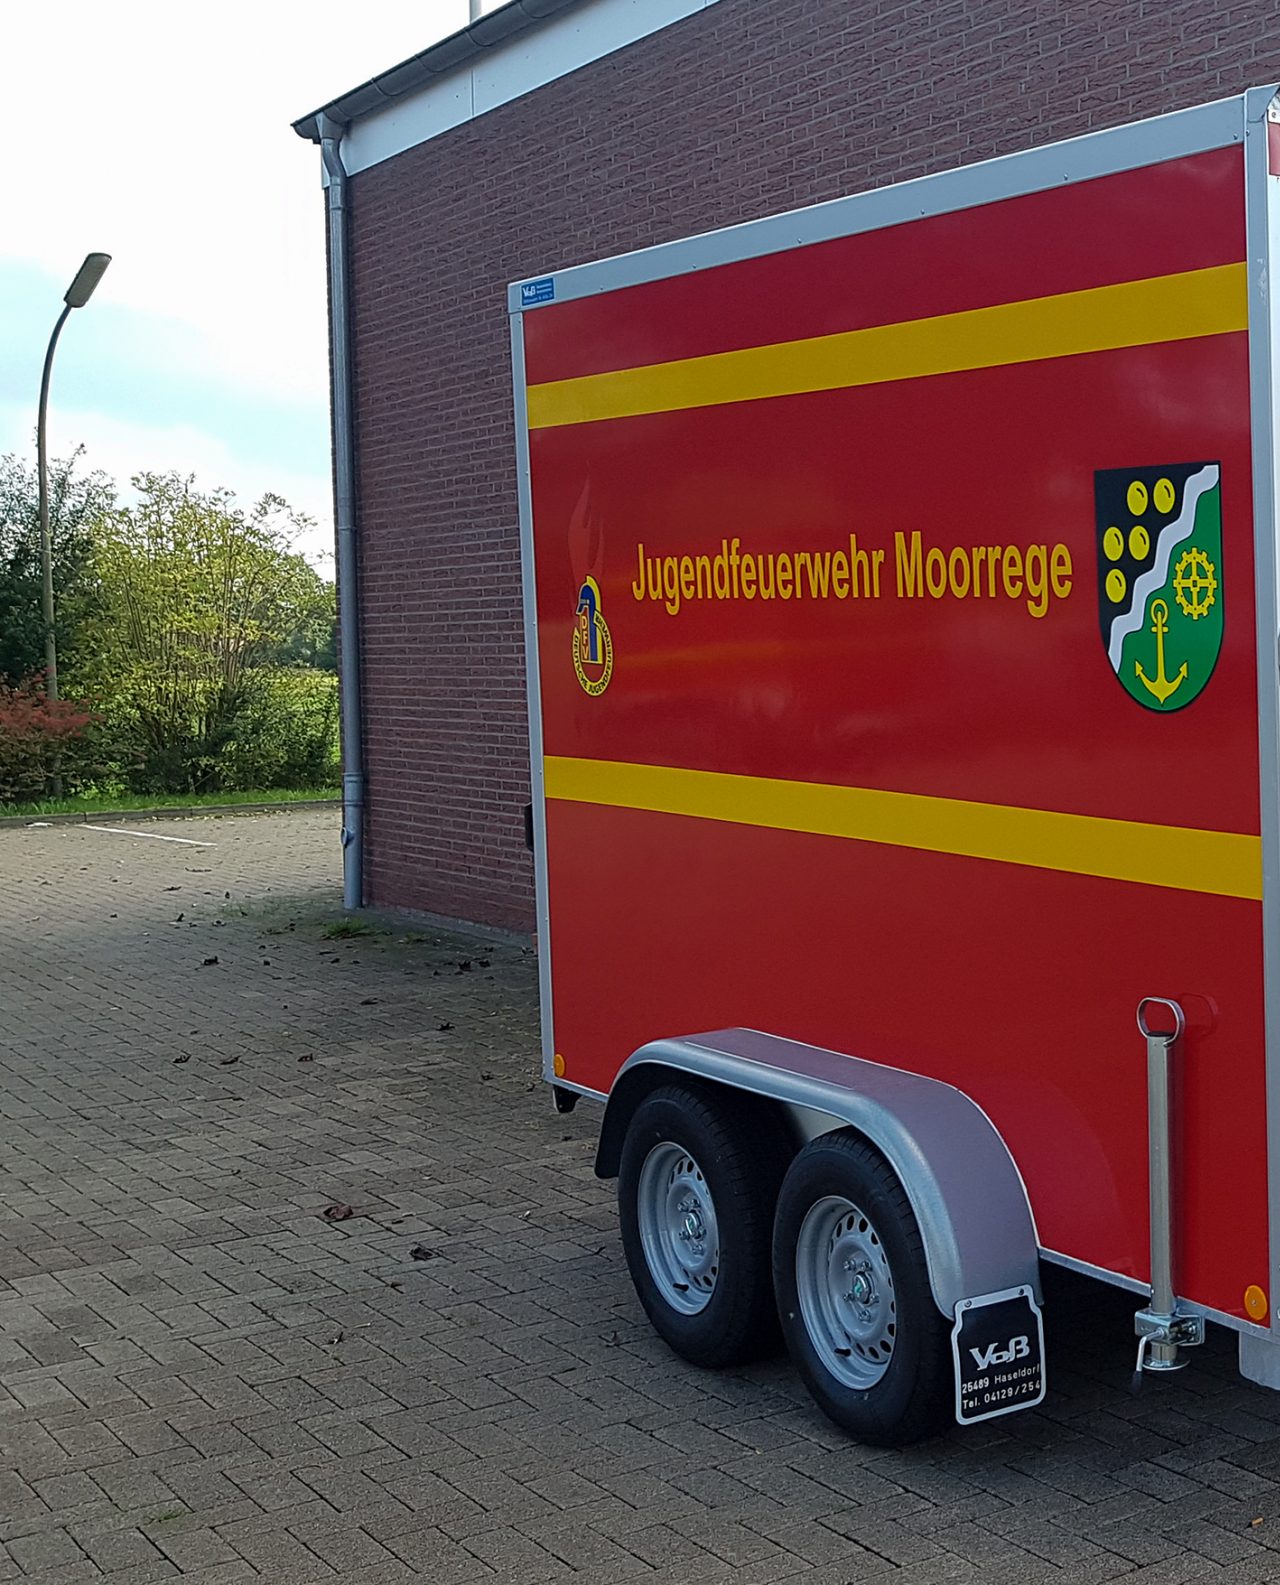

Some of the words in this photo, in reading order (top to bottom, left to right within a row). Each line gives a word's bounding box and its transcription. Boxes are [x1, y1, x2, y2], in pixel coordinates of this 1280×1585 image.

[632, 534, 884, 615] Jugendfeuerwehr
[895, 530, 1073, 618] Moorrege
[969, 1335, 1030, 1371] Voß
[962, 1377, 989, 1394] 25489
[963, 1397, 980, 1409] Tel.
[984, 1380, 1040, 1403] 04129/254
